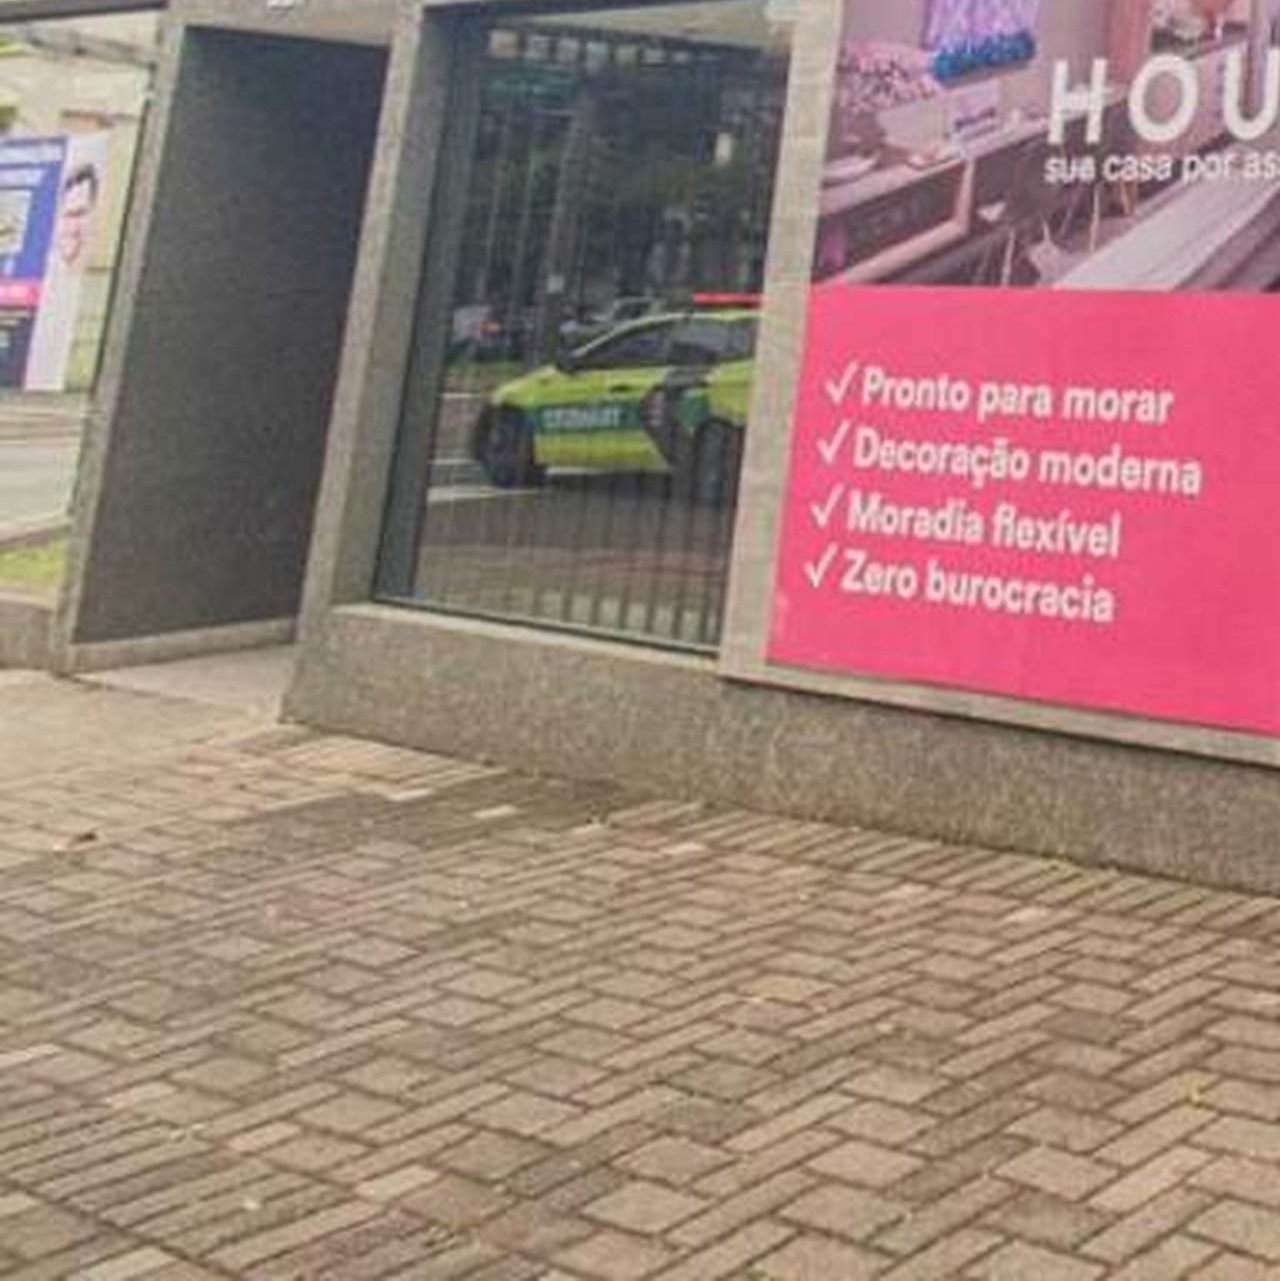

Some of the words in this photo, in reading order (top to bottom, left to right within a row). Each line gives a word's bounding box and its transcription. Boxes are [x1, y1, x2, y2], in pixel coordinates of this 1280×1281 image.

[1044, 154, 1096, 183] sua
[1103, 152, 1172, 182] casa
[1181, 153, 1236, 183] por
[863, 366, 970, 411] Pronto
[978, 380, 1052, 420] para
[1063, 386, 1175, 425] morar
[854, 427, 1030, 488] Decoração
[1039, 445, 1202, 495] moderna
[847, 490, 984, 543] Moradia
[993, 502, 1121, 558] flexível
[841, 550, 918, 599] Zero
[926, 559, 1116, 623] burocracia
